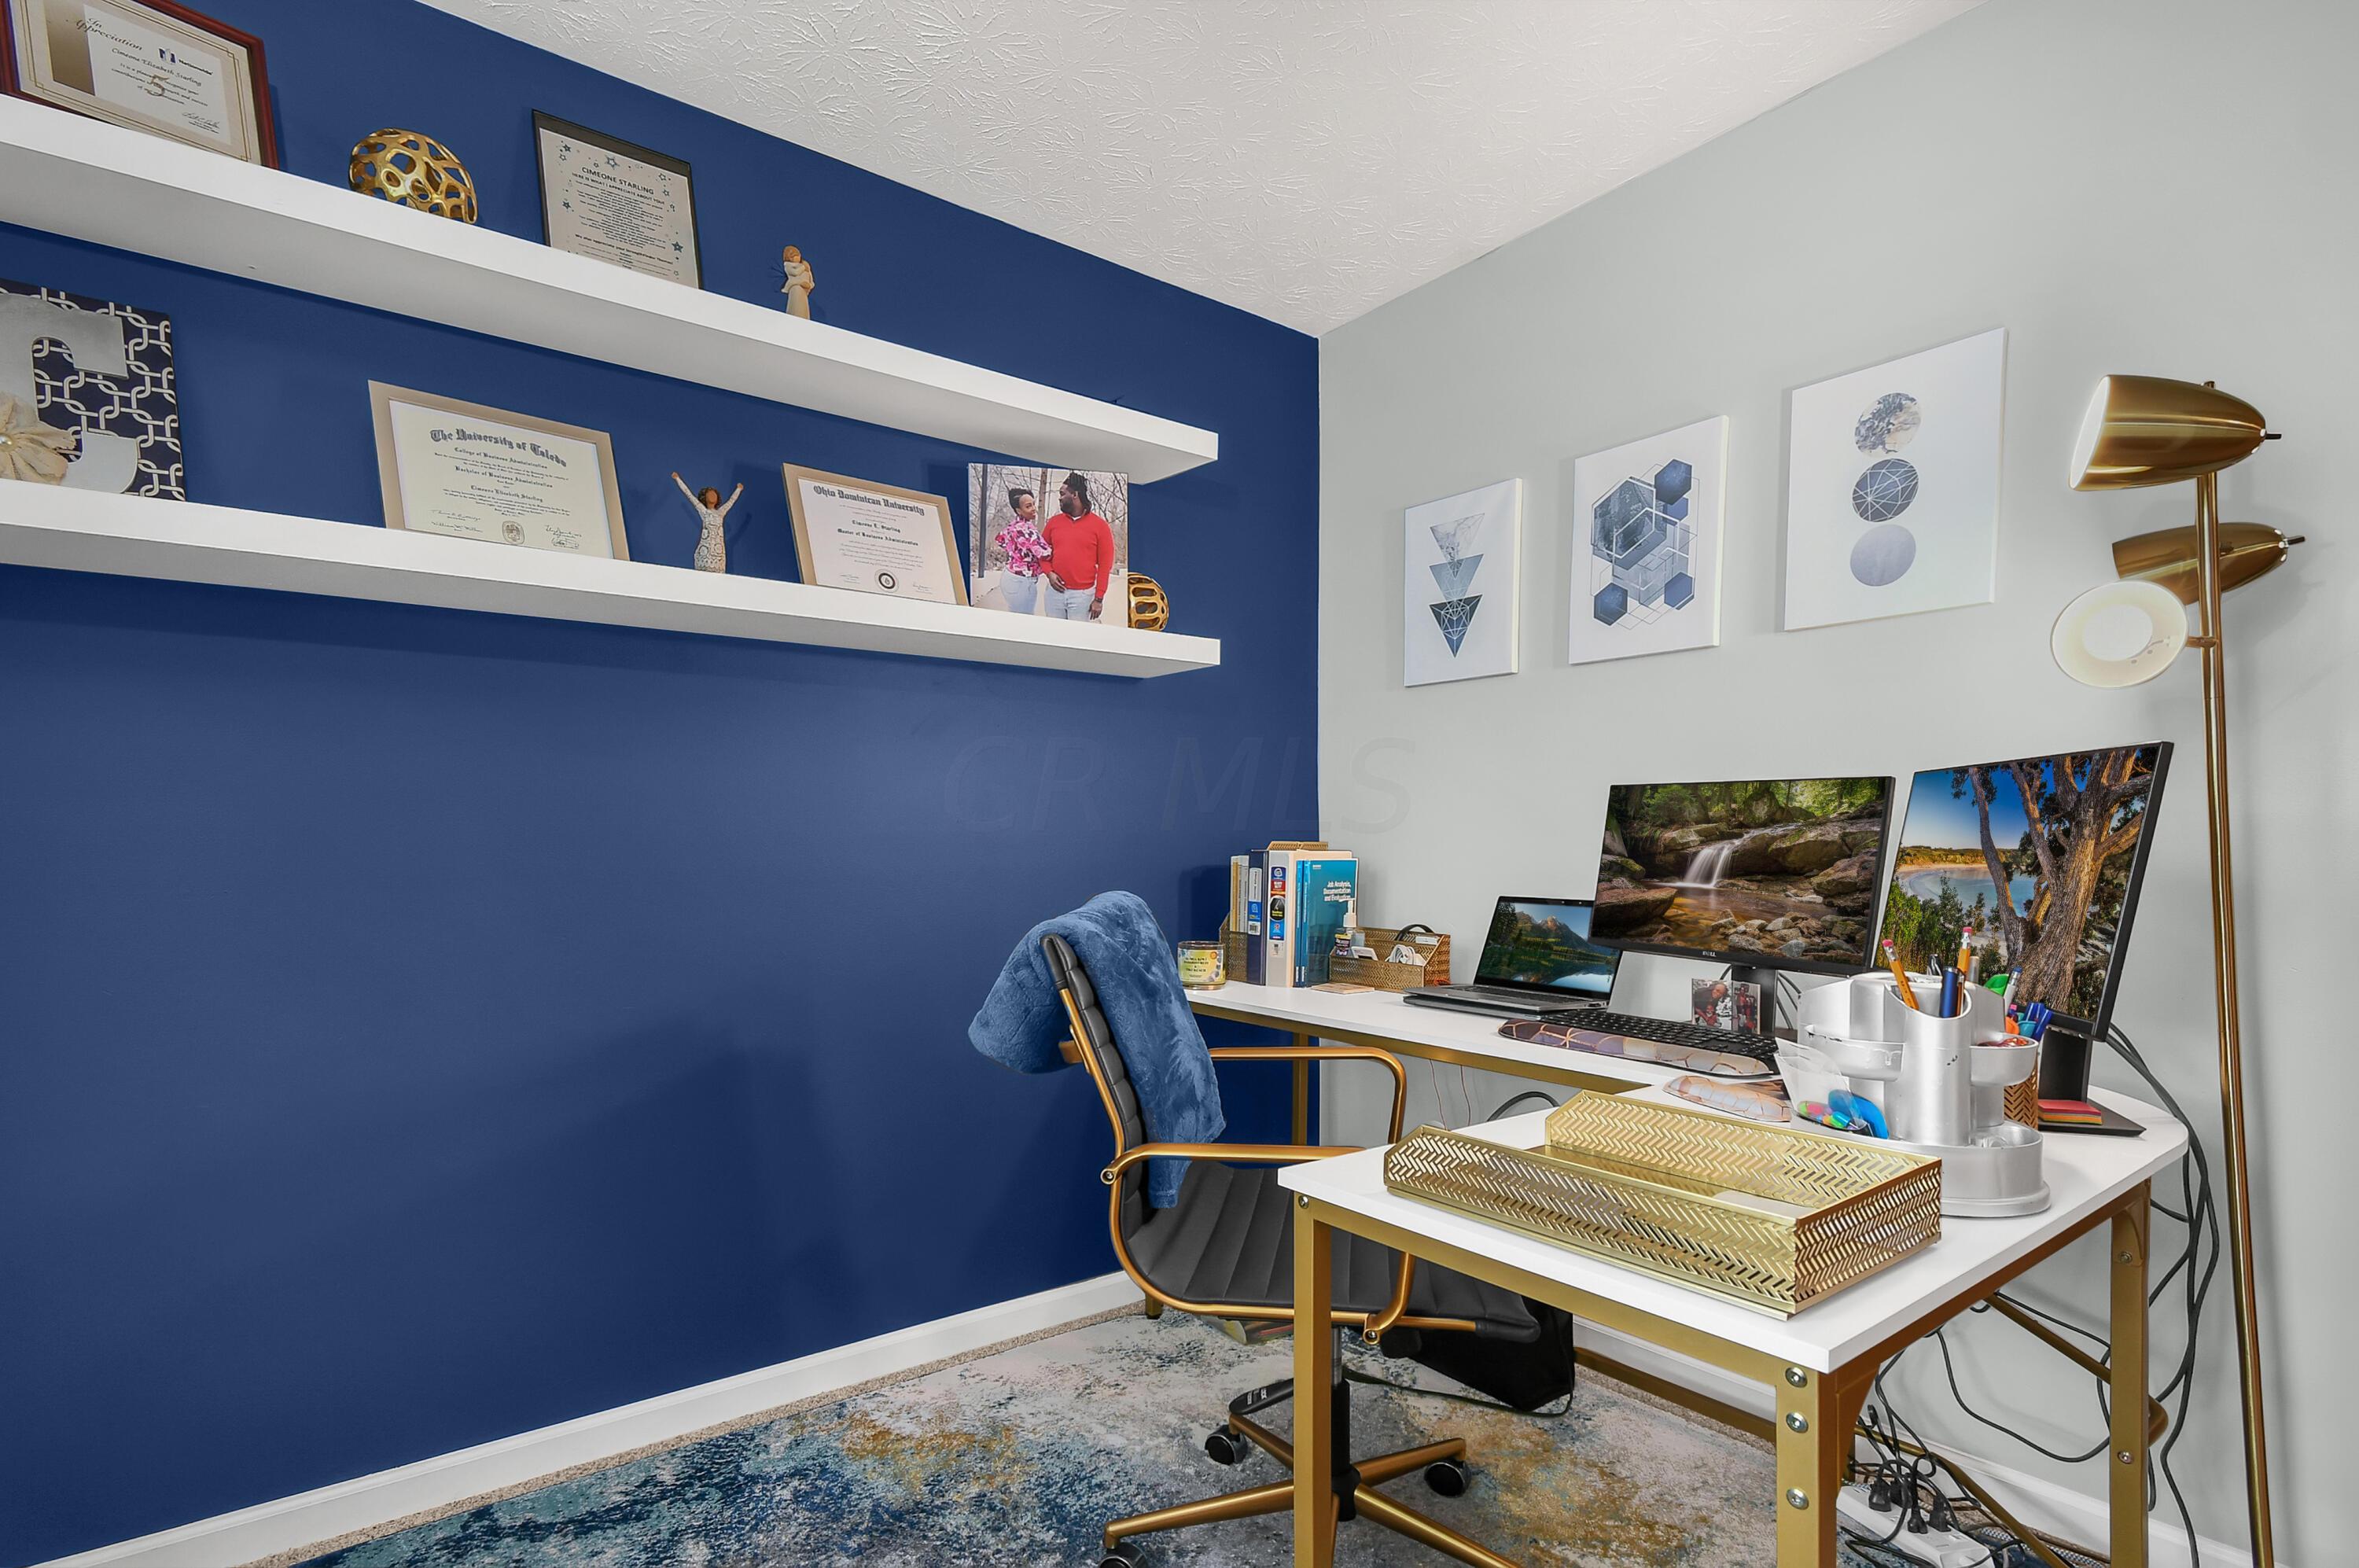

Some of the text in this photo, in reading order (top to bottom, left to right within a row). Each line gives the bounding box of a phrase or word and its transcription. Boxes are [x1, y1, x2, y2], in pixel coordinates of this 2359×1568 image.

[148, 74, 170, 97] 5
[582, 167, 653, 195] CIMEONE STARLING
[430, 429, 453, 442] The
[455, 429, 514, 449] University
[516, 441, 528, 451] of
[529, 443, 567, 467] Toledo
[814, 485, 836, 497] Ohio
[837, 489, 881, 506] Dominican
[882, 498, 925, 516] University
